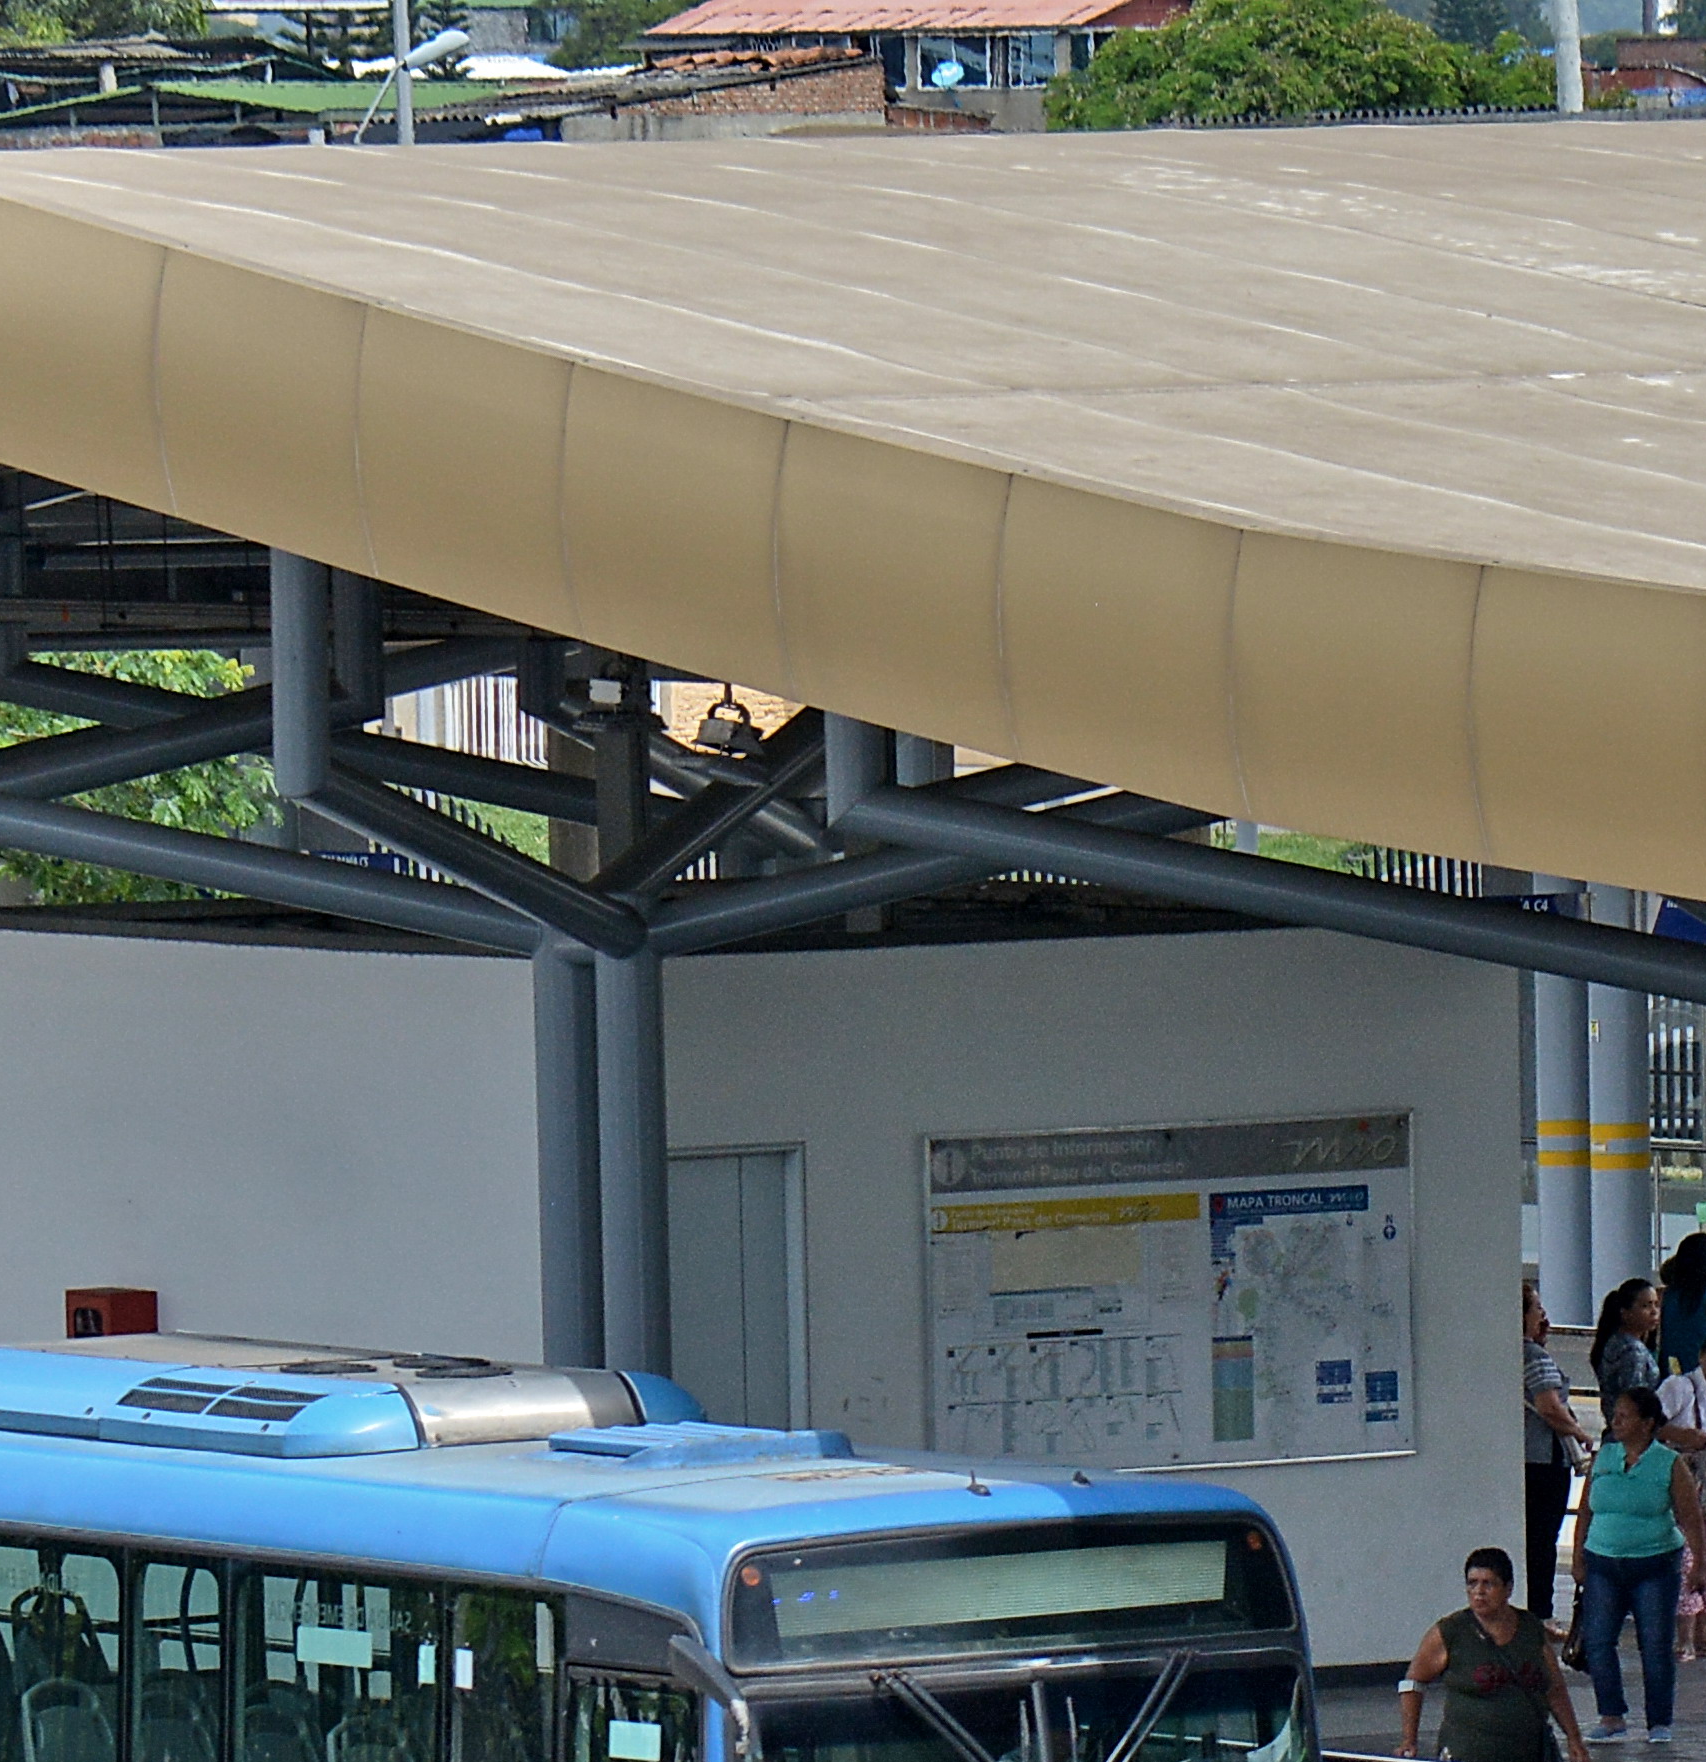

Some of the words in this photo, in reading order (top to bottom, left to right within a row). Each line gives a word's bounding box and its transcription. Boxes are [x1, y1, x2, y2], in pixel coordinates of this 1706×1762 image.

[1227, 1195, 1264, 1209] MAPA
[1266, 1192, 1324, 1207] TRONCAL
[1385, 1214, 1394, 1223] N
